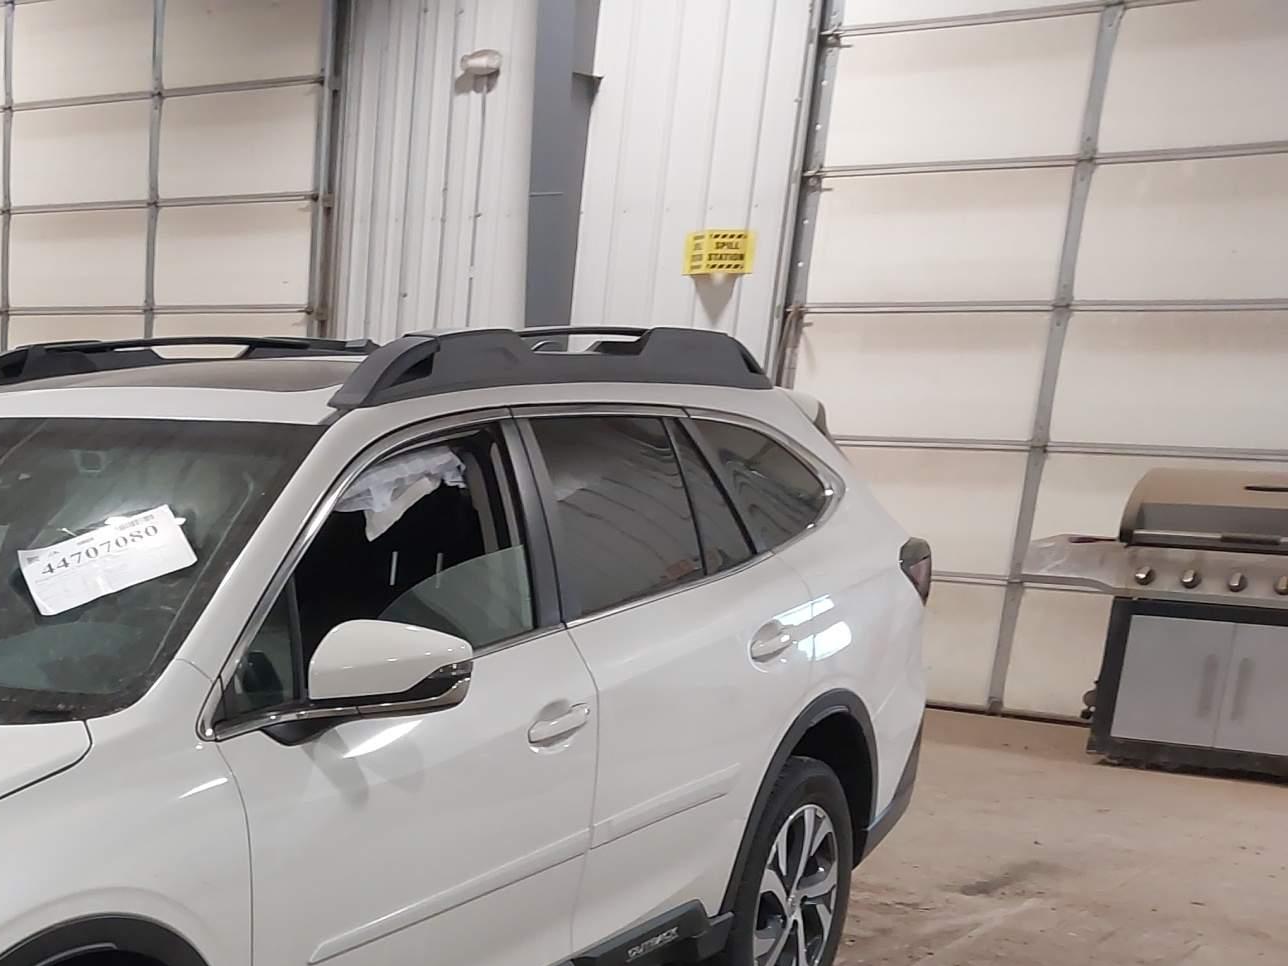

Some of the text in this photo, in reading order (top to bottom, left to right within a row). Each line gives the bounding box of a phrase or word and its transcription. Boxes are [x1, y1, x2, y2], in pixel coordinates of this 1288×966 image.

[714, 241, 741, 250] SPILL
[707, 252, 745, 261] STATION
[40, 524, 160, 575] 44707080
